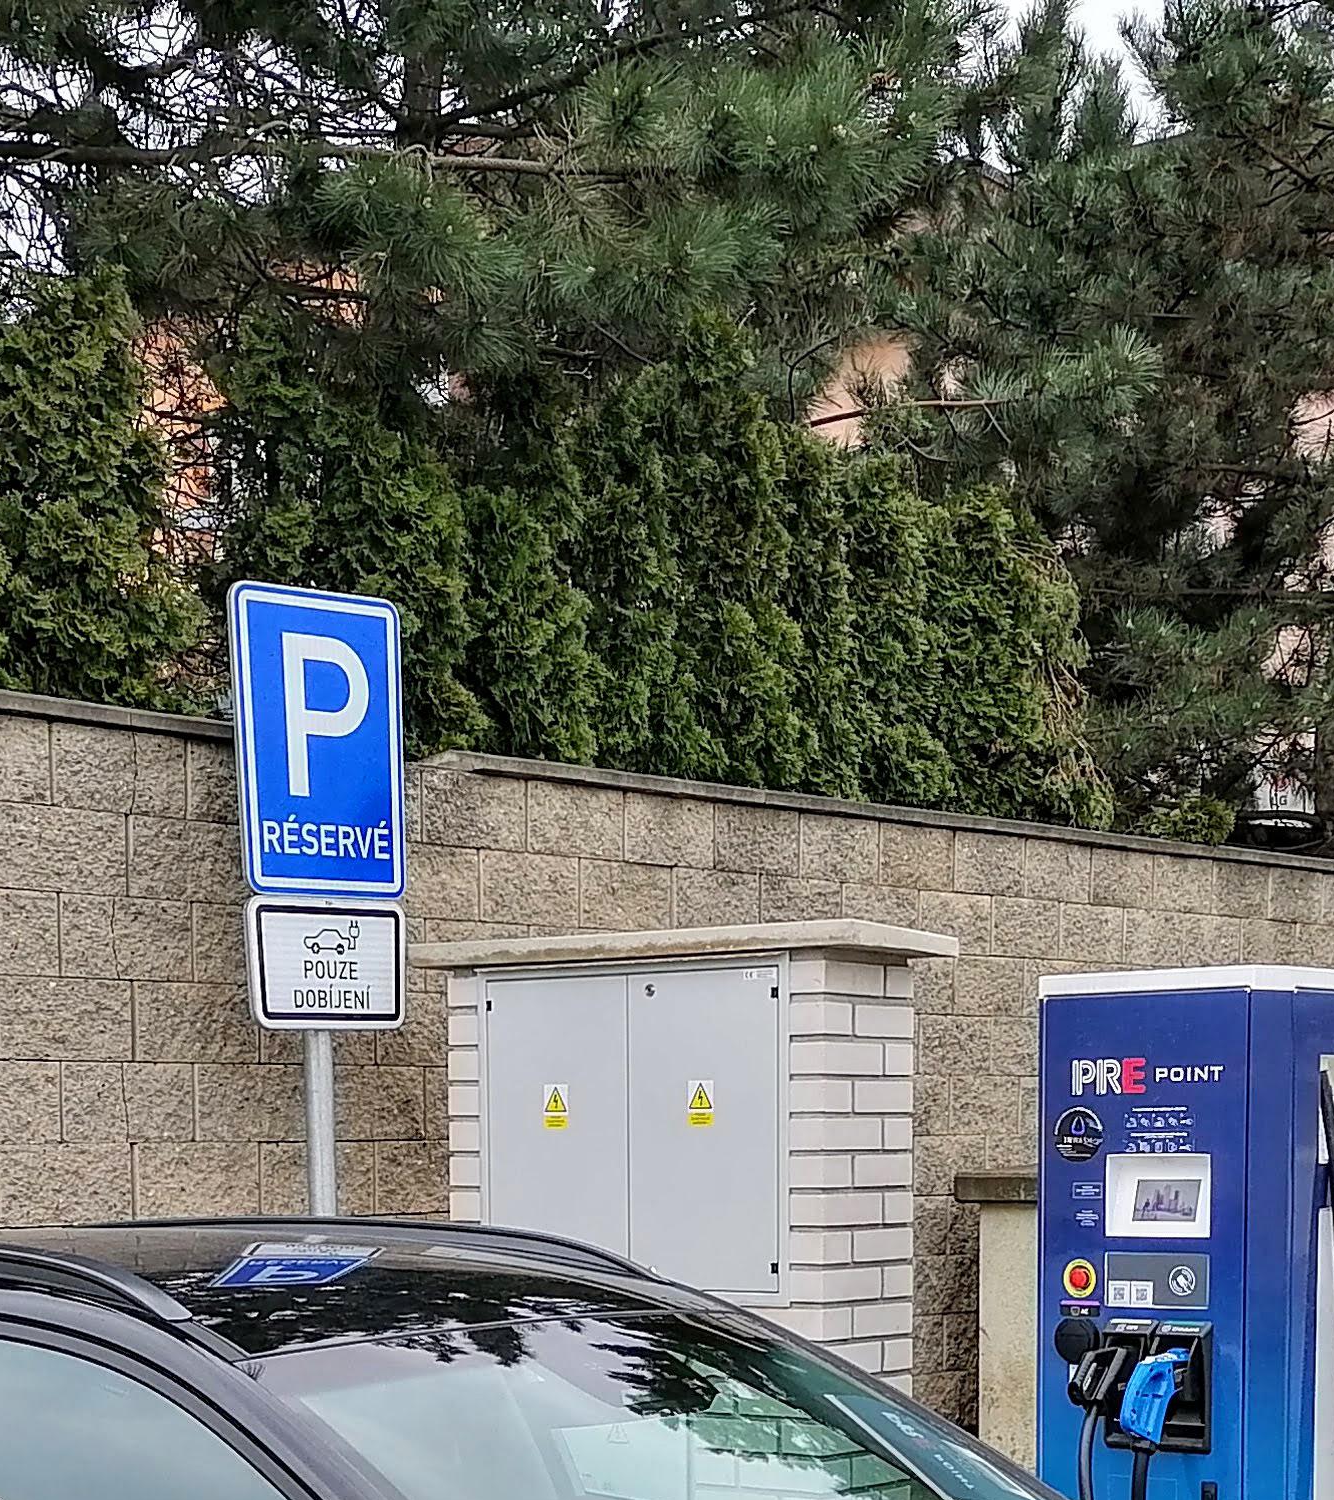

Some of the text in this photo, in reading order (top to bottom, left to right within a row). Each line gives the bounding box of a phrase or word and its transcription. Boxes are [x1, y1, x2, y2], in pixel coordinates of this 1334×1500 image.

[282, 631, 369, 798] P
[263, 814, 390, 861] RÉSERVÉ
[303, 959, 359, 981] POUZE
[293, 984, 371, 1010] DOBÍJENÍ
[1071, 1057, 1224, 1096] PRE POINT
